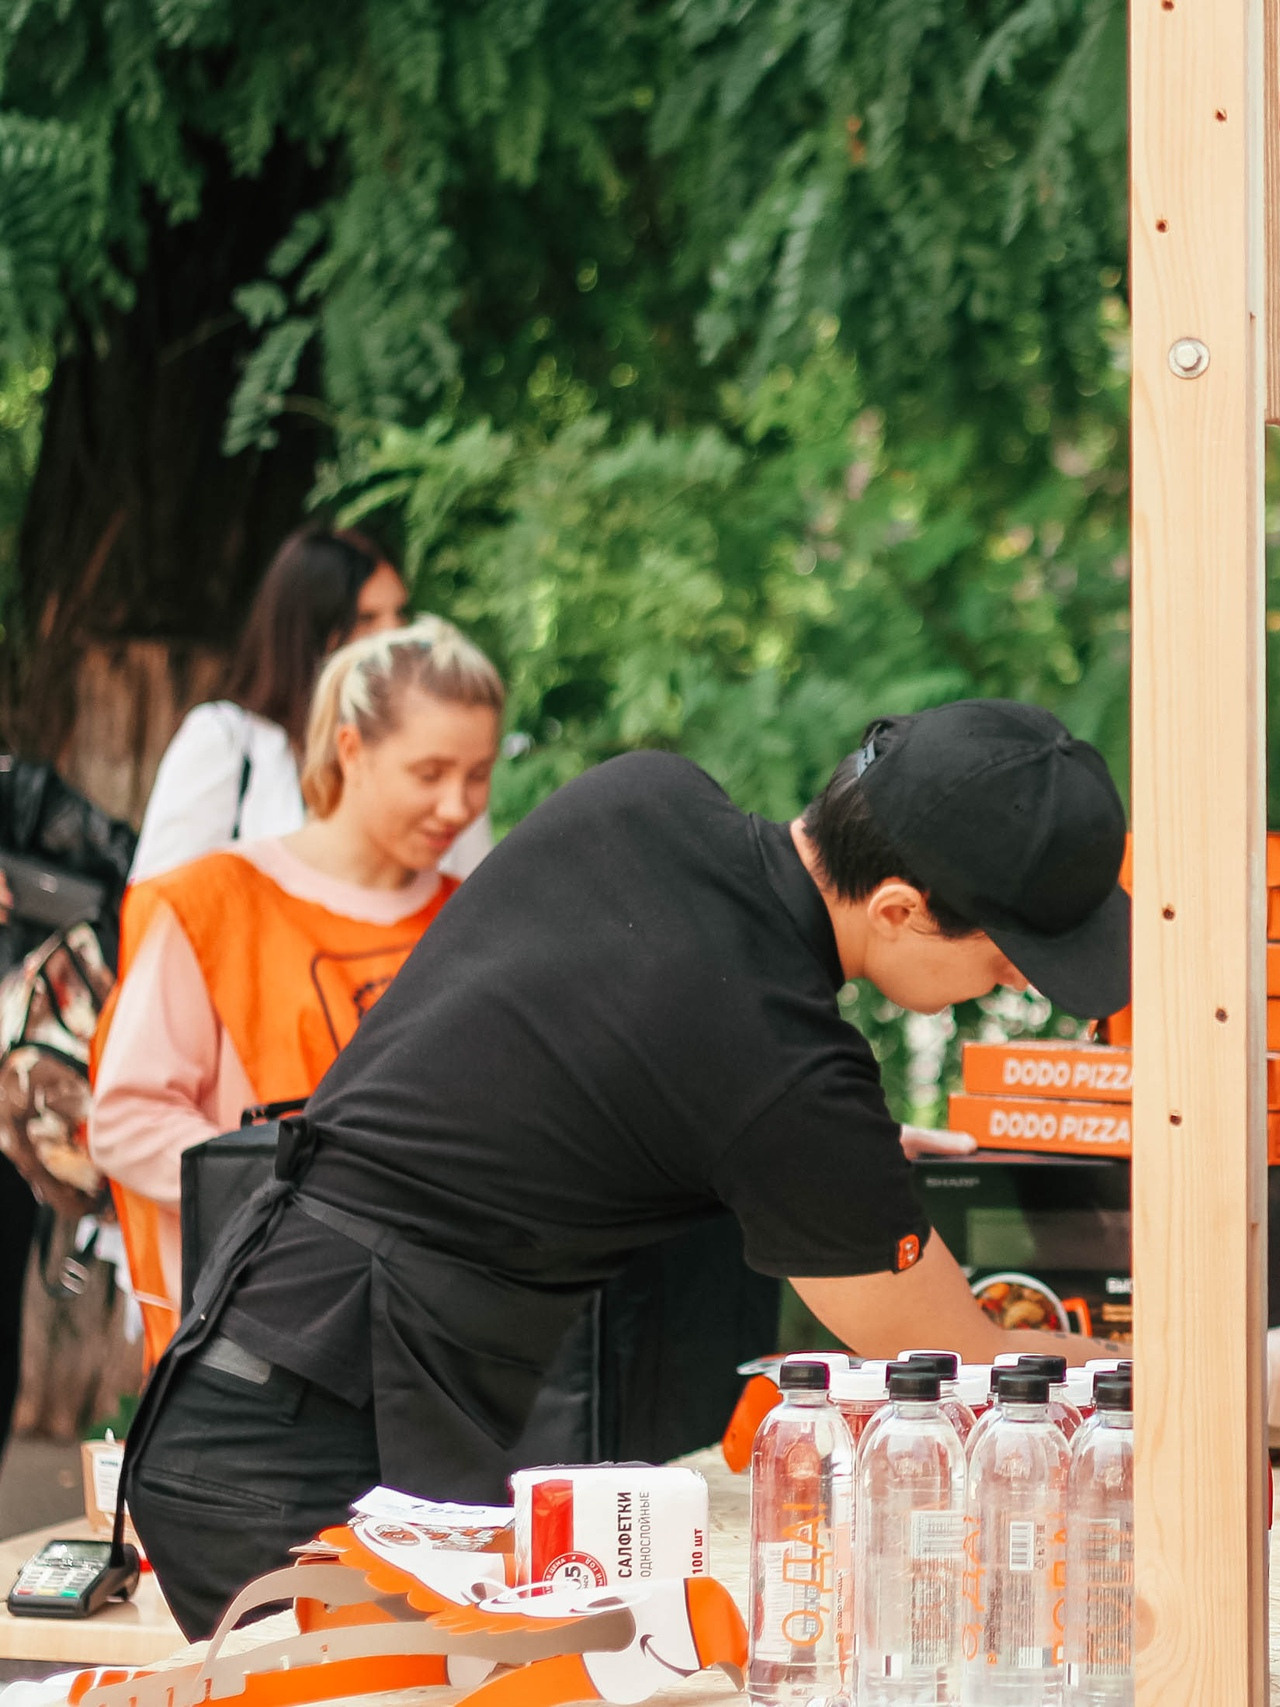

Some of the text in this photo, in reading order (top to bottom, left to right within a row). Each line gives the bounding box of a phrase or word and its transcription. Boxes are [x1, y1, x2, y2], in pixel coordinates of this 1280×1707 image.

[1003, 1057, 1132, 1091] DODO PIZZ
[988, 1108, 1131, 1144] DODO PIZZA
[616, 1491, 633, 1579] САЛФЕТКИ
[638, 1491, 651, 1578] ОДНОСЛОЙНЫЕ
[691, 1551, 704, 1575] 100
